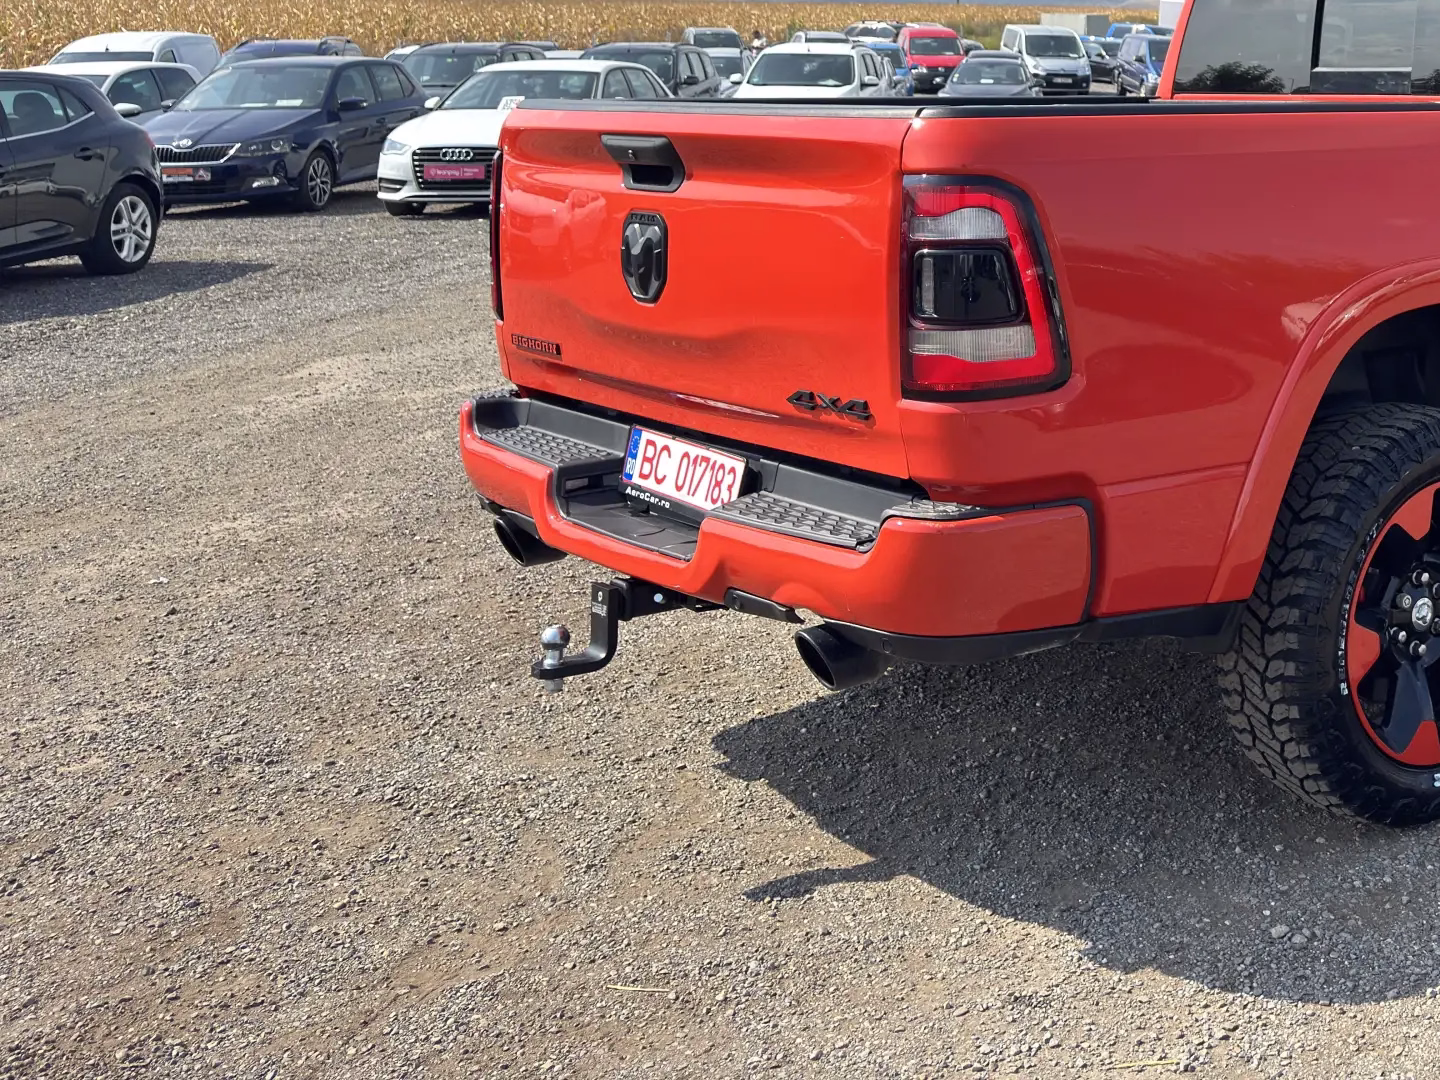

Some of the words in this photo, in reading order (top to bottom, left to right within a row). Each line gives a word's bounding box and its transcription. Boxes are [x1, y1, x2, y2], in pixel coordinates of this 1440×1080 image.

[512, 335, 558, 355] BIGHORN
[625, 458, 637, 476] RO
[639, 438, 672, 485] BC
[675, 451, 737, 505] 017183
[625, 486, 671, 508] AeroCar.ro
